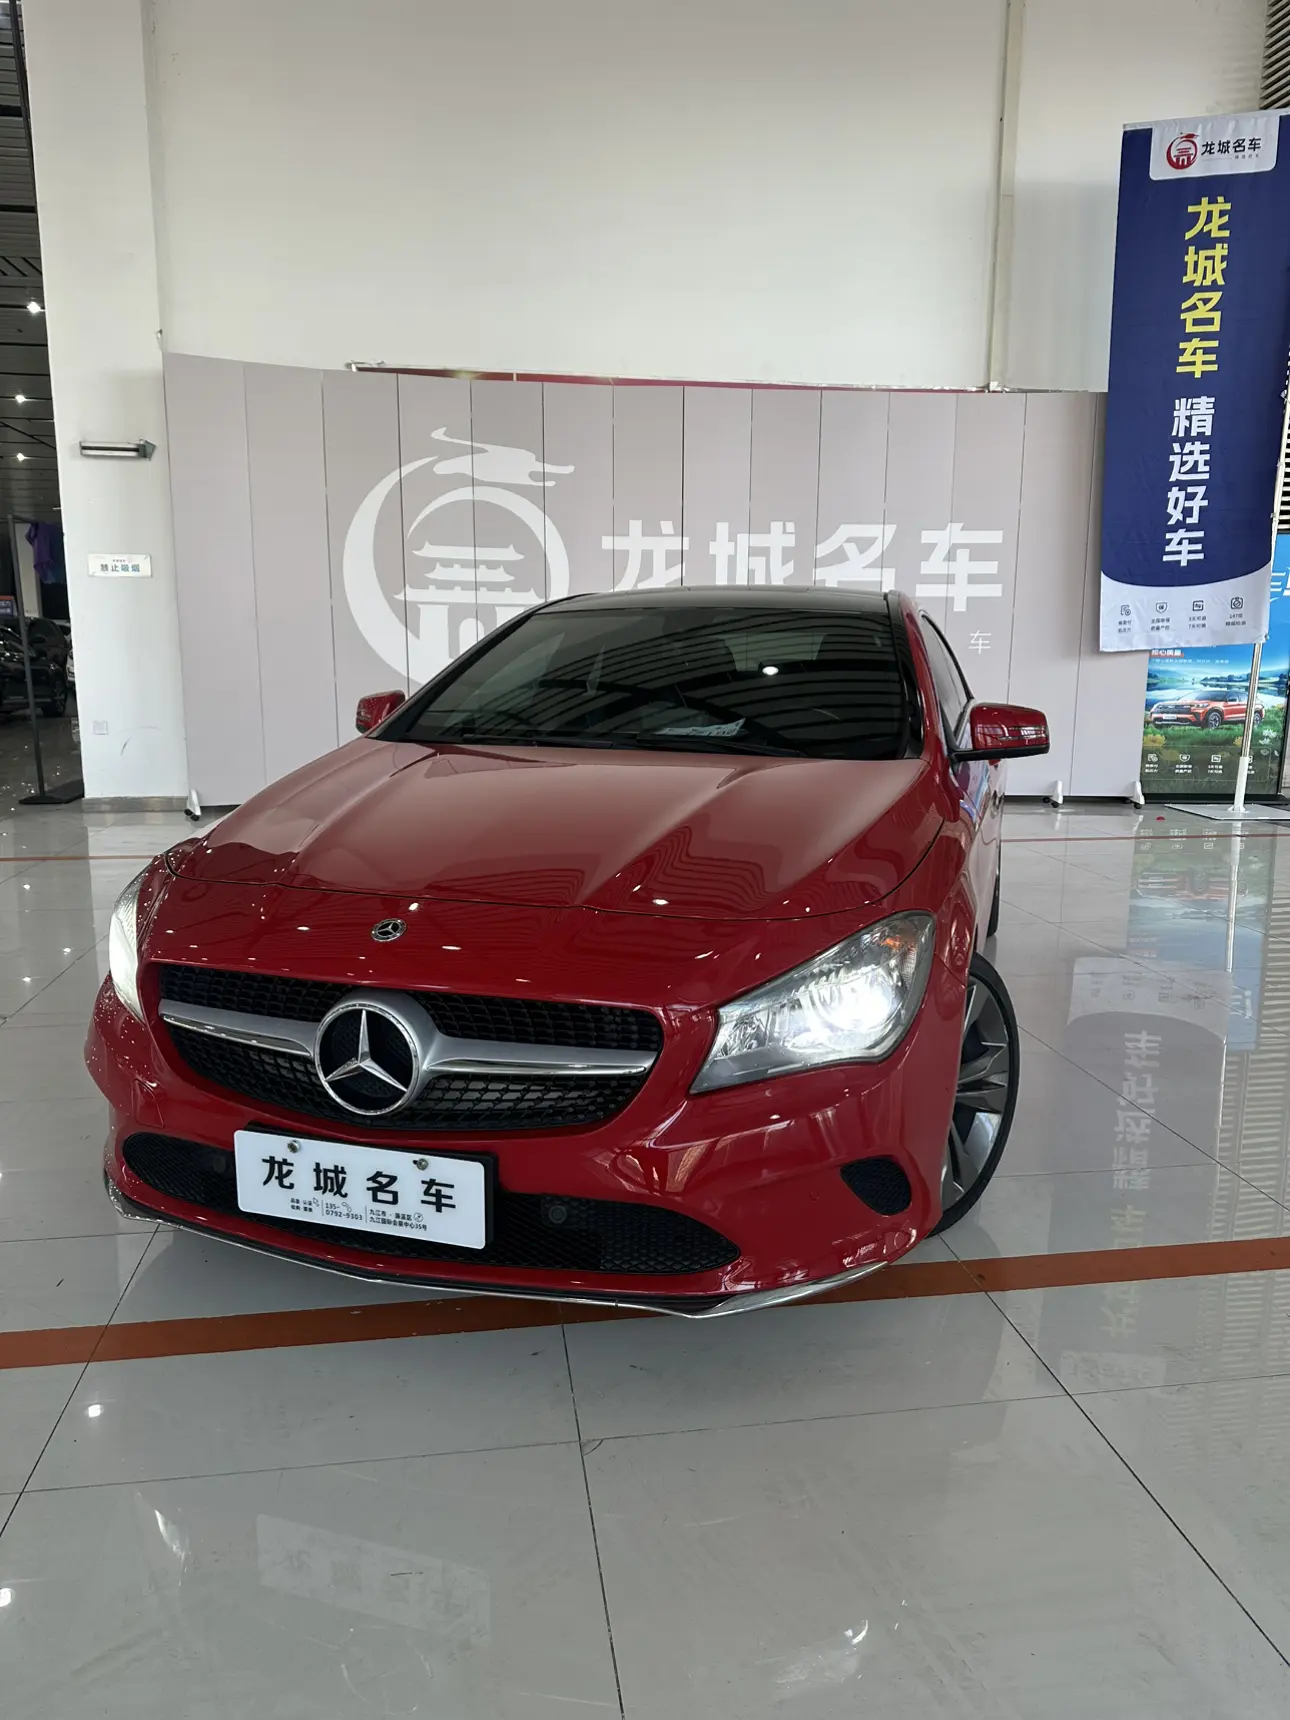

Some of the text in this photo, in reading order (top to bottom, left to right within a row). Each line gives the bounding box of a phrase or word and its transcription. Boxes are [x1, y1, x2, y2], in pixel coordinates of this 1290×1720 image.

[1201, 137, 1262, 156] 龙城名车
[1162, 196, 1231, 567] 龙城名车 精选好车
[601, 520, 1003, 611] 龙城名车
[968, 630, 991, 655] 车
[262, 1155, 456, 1213] 龙城名车
